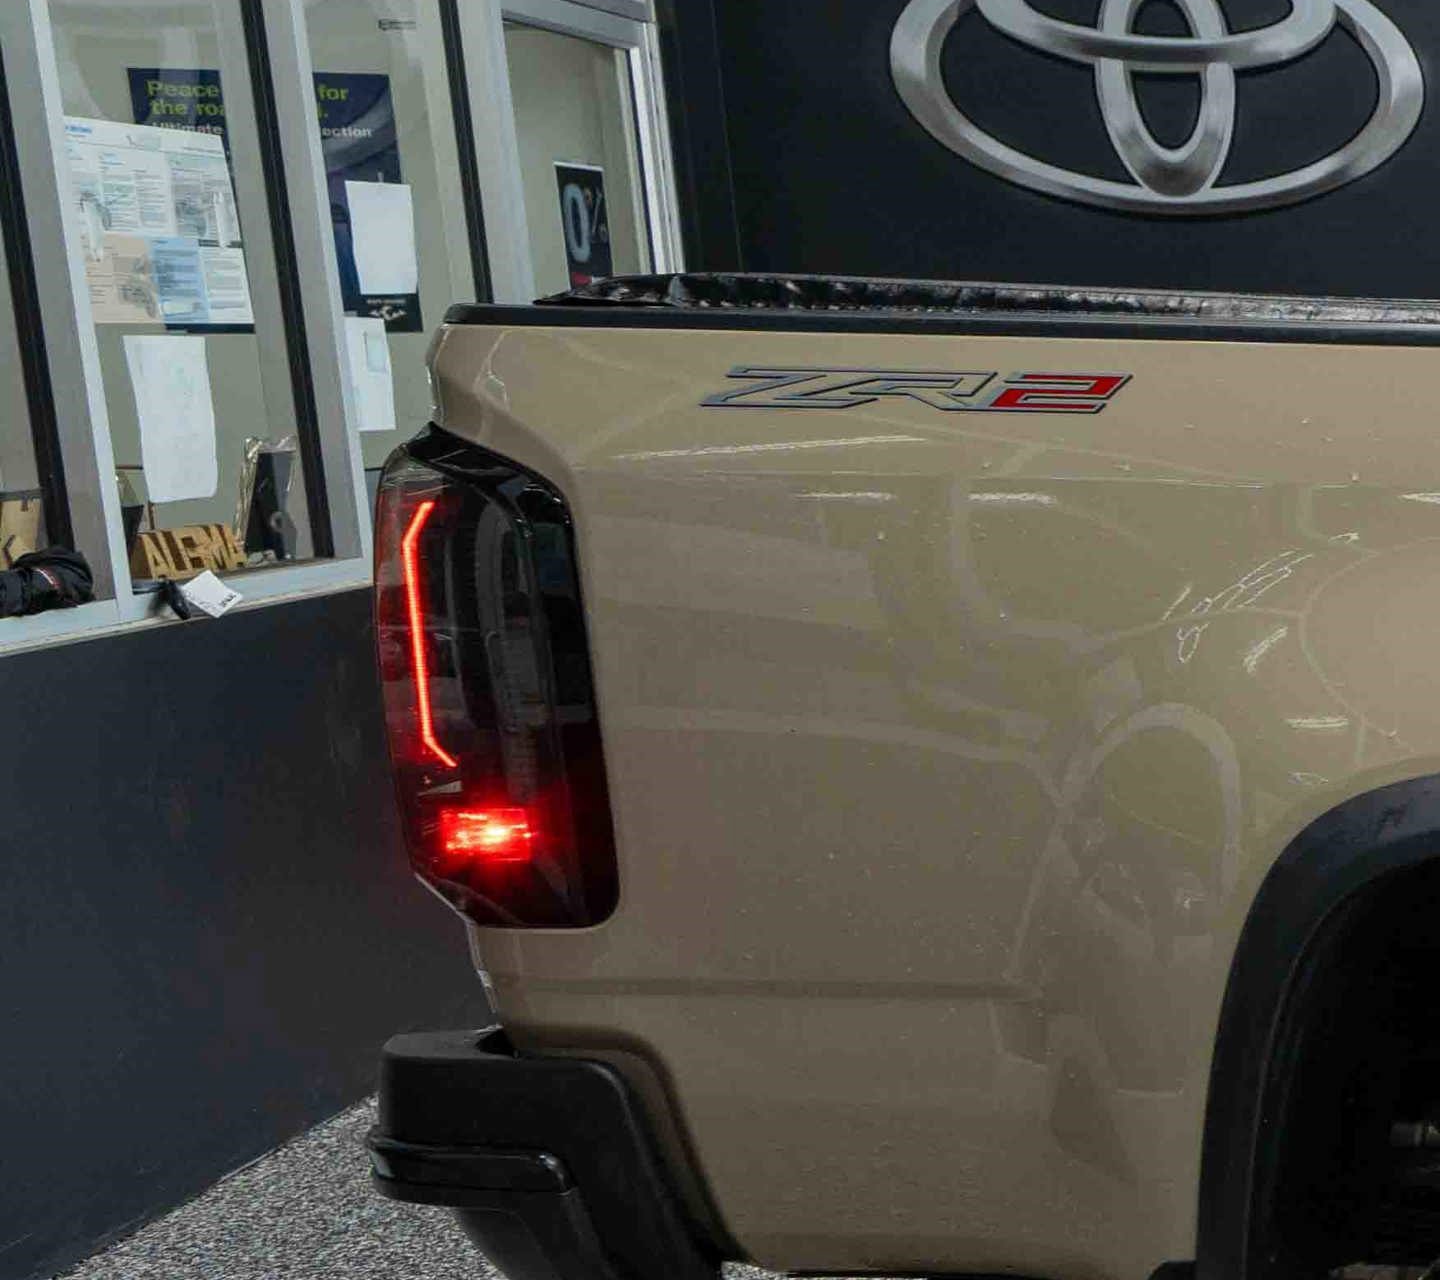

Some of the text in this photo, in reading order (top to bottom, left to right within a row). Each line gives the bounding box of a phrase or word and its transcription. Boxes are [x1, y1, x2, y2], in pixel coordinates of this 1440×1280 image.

[148, 80, 349, 101] Peace for
[151, 99, 225, 116] the roa
[321, 125, 373, 138] ection
[698, 365, 1133, 414] ZR2
